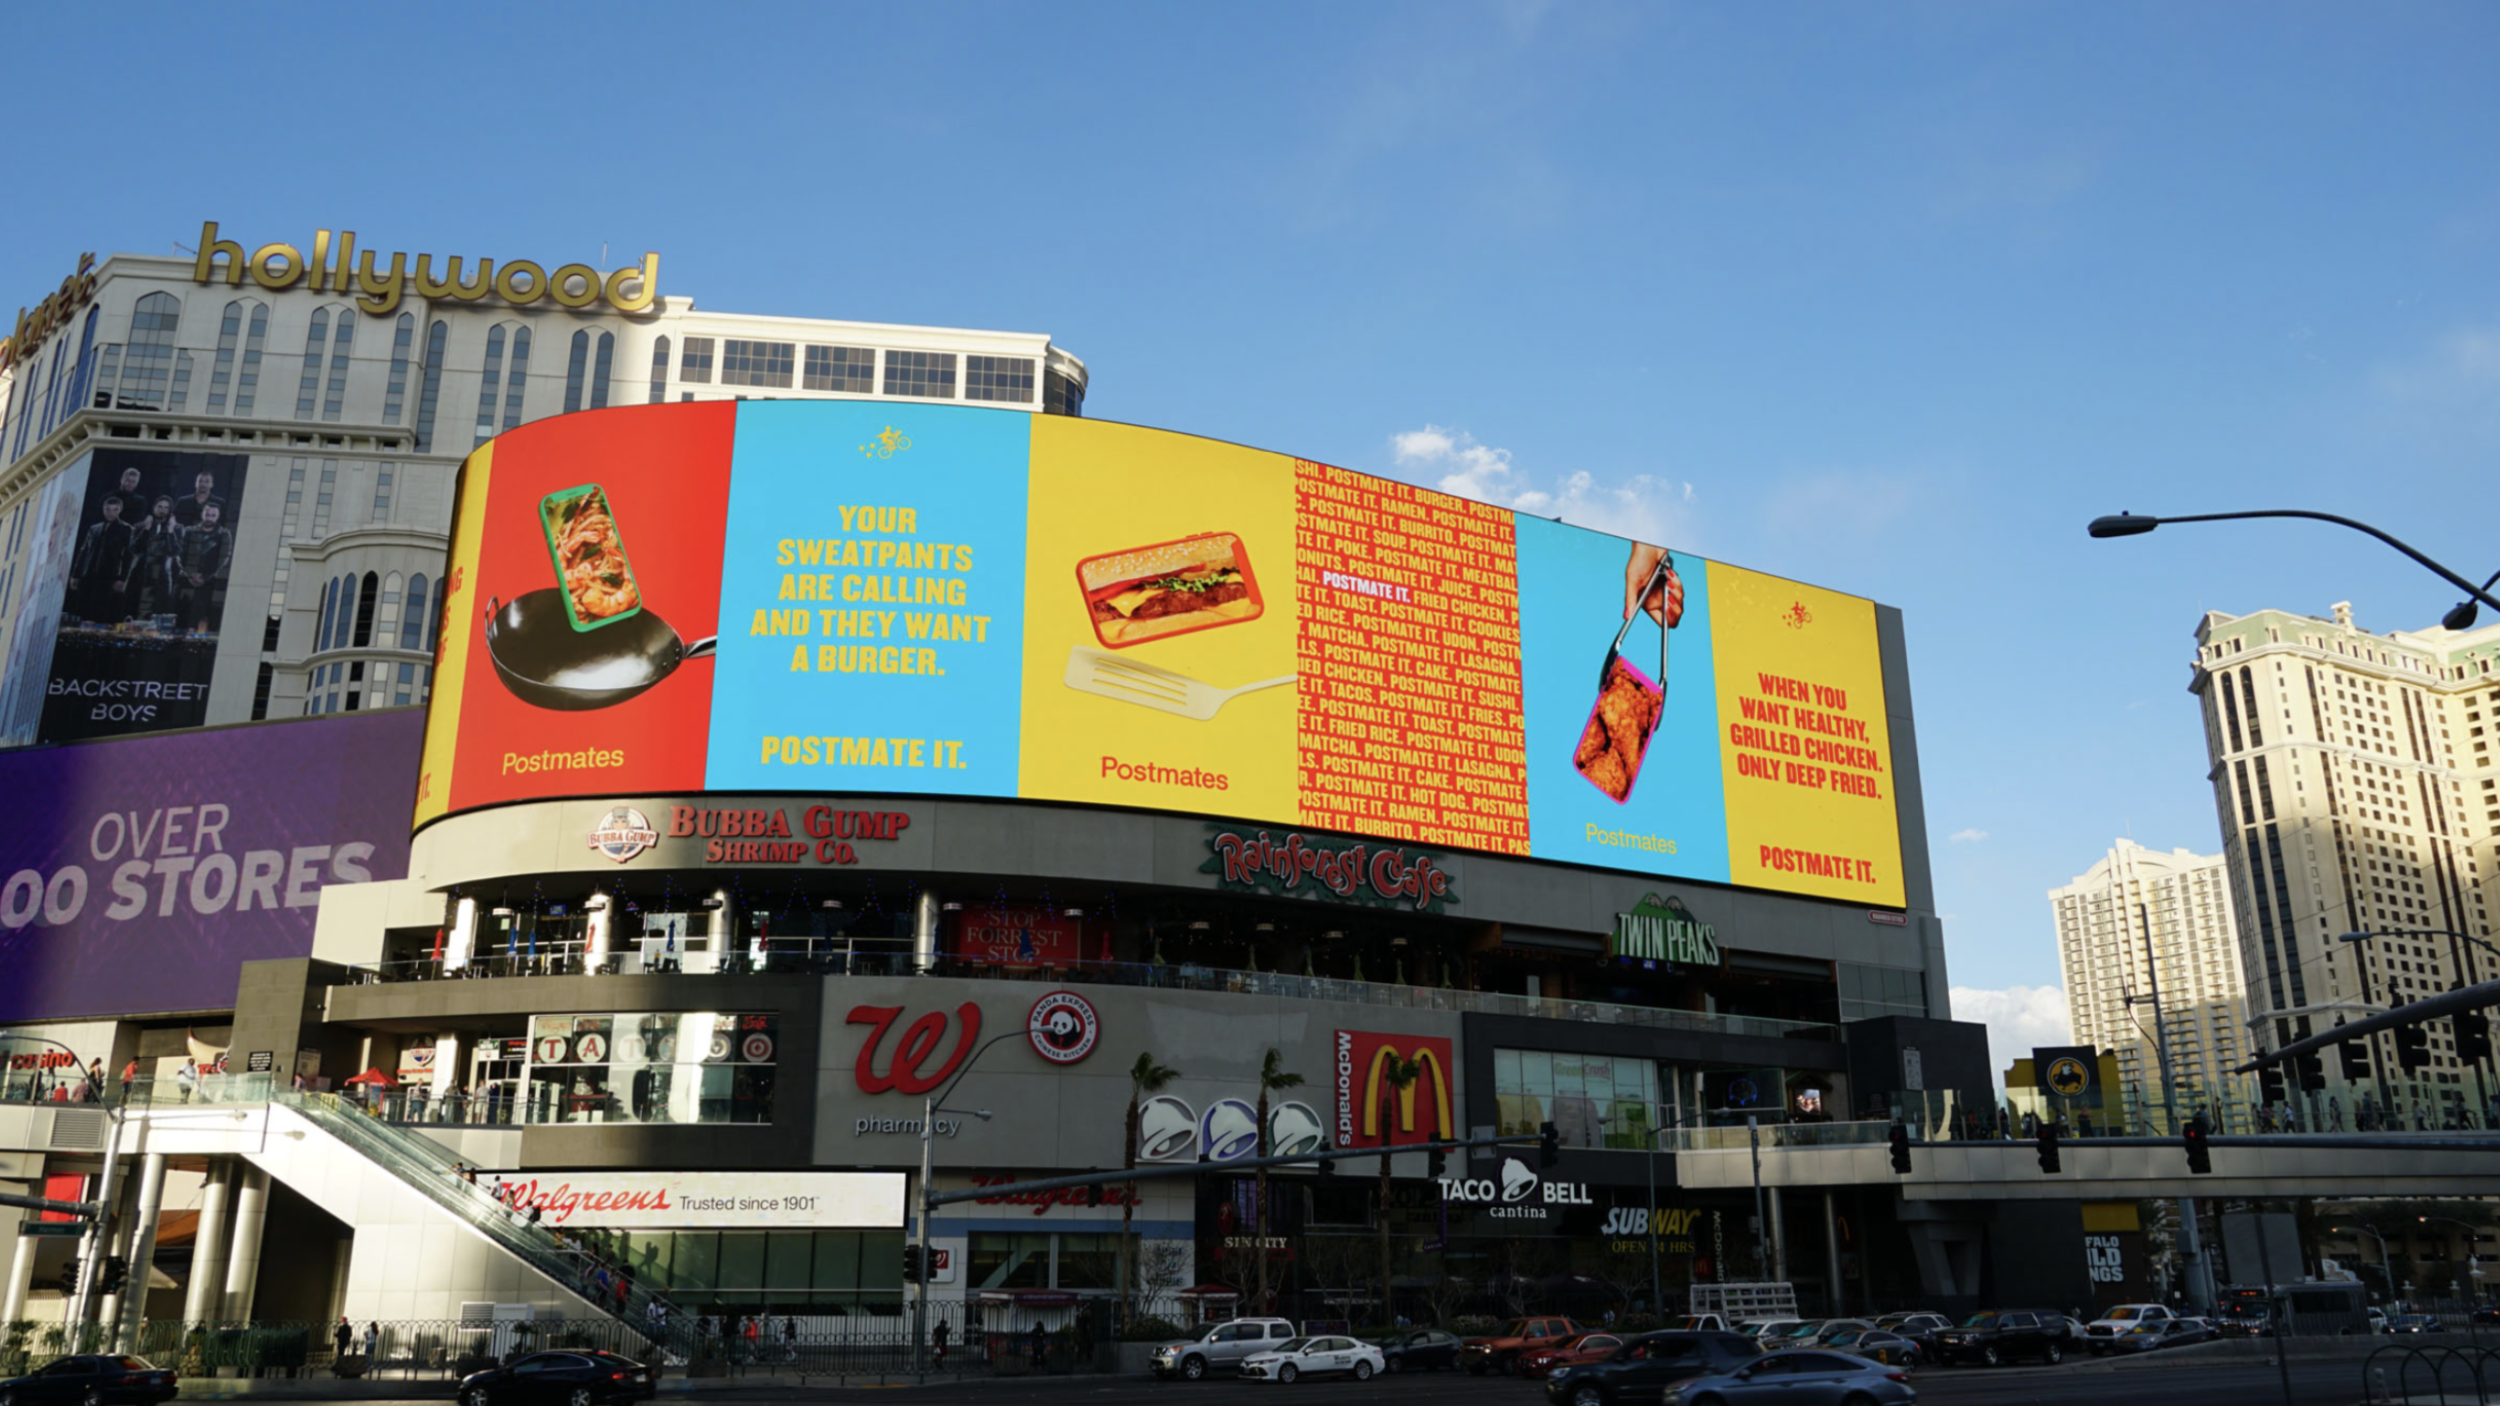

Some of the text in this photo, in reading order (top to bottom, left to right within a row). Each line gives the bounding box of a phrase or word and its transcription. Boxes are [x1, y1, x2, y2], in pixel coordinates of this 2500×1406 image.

[194, 222, 660, 315] hollywood
[1326, 466, 1394, 496] POSTMATE
[1397, 483, 1411, 500] IT.
[1414, 487, 1466, 513] BURGER.
[839, 506, 916, 533] YOUR
[1309, 496, 1456, 544] POSTMATE IT. BURRITO.
[1363, 492, 1512, 541] IT. RAMEN. POSTMATE IT.
[777, 539, 973, 571] SWEATPANTS
[1316, 533, 1459, 579] IT. POKE. POSTMATE IT.
[1409, 537, 1475, 566] POSTMATE
[1478, 553, 1492, 569] IT.
[779, 574, 968, 605] ARE CALLING
[1323, 570, 1508, 624] POSTMATE IT. FRIED CHICKEN.
[1348, 557, 1476, 600] POSTMATE IT. JUICE.
[751, 610, 991, 642] AND THEY WANT
[1315, 604, 1480, 652] RICE. POSTMATE IT. UDON.
[1333, 590, 1465, 632] TOAST. POSTMATE IT.
[791, 645, 944, 676] A BURGER.
[1324, 642, 1452, 681] POSTMATE IT. CAKE.
[1372, 633, 1440, 661] POSTMATE
[1460, 651, 1519, 677] LASAGNA.
[48, 678, 209, 700] BACKSTREET
[1324, 660, 1519, 712] CHICKEN. POSTMATE IT. SUSHI.
[1329, 680, 1506, 727] TACOS. POSTMATE IT. FRIES.
[1758, 673, 1847, 711] WHEN YOU
[90, 702, 158, 722] BOYS
[1319, 696, 1524, 748] POSTMATE IT. TOAST. POSTMATE
[1739, 697, 1870, 744] WANT HEALTHY,
[762, 736, 967, 769] POSTMATE IT.
[1310, 713, 1492, 760] IT. FRIED RICE. POSTMATE IT.
[1730, 723, 1883, 773] GRILLED CHICKEN.
[502, 746, 624, 776] Postmates
[1101, 756, 1229, 790] Postmates
[1322, 753, 1522, 801] POSTMATE CAKE. POSTMATE
[1364, 741, 1434, 768] POSTMATE
[1437, 754, 1452, 771] IT.
[1455, 757, 1514, 782] LASAGNA.
[1737, 753, 1882, 800] ONLY DEEP FRIED.
[1315, 771, 1469, 811] POSTMATE IT. HOT DOG.
[90, 803, 230, 861] OVER
[590, 830, 655, 845] BUBBA GUMP
[668, 805, 911, 840] BUBBA GUMP
[1335, 812, 1505, 853] IT. BURRITO. POSTMATE IT.
[1370, 798, 1527, 838] IT. RAMEN. POSTMATE IT.
[706, 838, 859, 864] SHRIMP CO.
[1586, 822, 1677, 854] Postmates
[104, 841, 376, 921] STORES
[1214, 830, 1448, 909] Rainforest Cafe
[1760, 845, 1876, 884] POSTMATE IT.
[988, 910, 1042, 929] STOP
[1618, 912, 1721, 967] TWIN PEAKS
[1033, 995, 1095, 1027] PANDA EXPRESS
[1034, 1033, 1092, 1059] CHINESE KITCHEN
[1337, 1031, 1353, 1147] McDonald's
[856, 1115, 960, 1138] pharmcy
[501, 1179, 671, 1223] Walgreens
[680, 1195, 735, 1211] Trusted
[738, 1196, 779, 1211] since
[1437, 1178, 1594, 1205] TACO BELL
[1489, 1205, 1548, 1220] cantina
[1600, 1206, 1702, 1237] SUBWAY
[1223, 1236, 1253, 1249] SIN
[1612, 1240, 1647, 1254] OPEN
[1669, 1241, 1696, 1255] HRS
[2084, 1235, 2120, 1248] FALO
[2089, 1266, 2125, 1283] NGS
